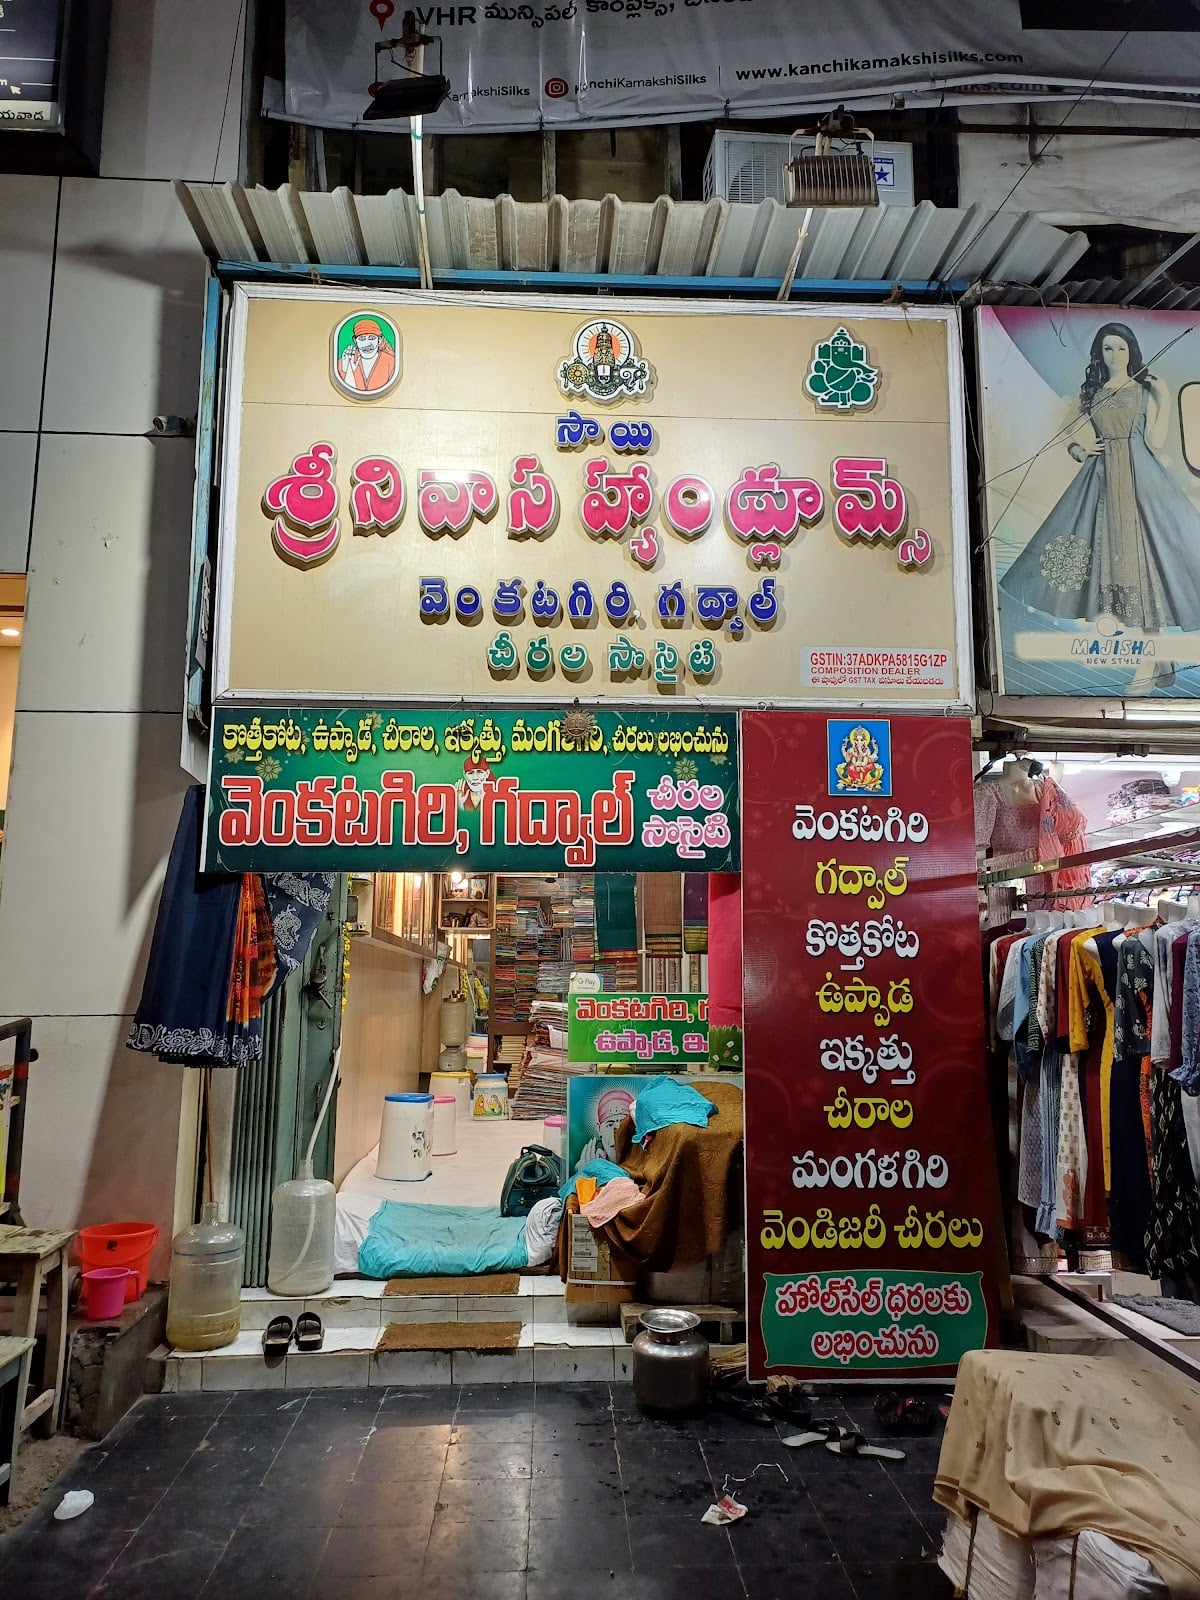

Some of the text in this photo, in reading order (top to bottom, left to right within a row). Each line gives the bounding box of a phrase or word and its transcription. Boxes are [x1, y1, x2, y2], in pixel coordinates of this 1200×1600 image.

[735, 50, 1024, 81] www.kanchikamakshisilks.com
[555, 409, 655, 452] సాయి
[658, 577, 779, 634] గద్వాల్
[488, 630, 589, 673] చీరల
[810, 652, 948, 668] GSTIN:37ADKPA5815G1ZP
[1071, 638, 1156, 656] MAJISHA
[1086, 657, 1142, 665] NEW STYLE
[810, 666, 921, 676] COMPOSITION DEALER
[848, 676, 862, 684] GST
[864, 676, 876, 684] TAX
[611, 724, 654, 753] చీరలు
[646, 775, 725, 811] చీరల
[480, 770, 636, 868] గద్వాల్
[791, 804, 930, 843] వెంకటగిరి
[815, 856, 910, 910] గద్వాల్
[805, 914, 920, 971] కొత్తకోట
[815, 971, 914, 1027] ఉప్పాడ
[819, 1033, 917, 1085] ఇక్కత్తు
[823, 1086, 914, 1129] చీరాల
[791, 1148, 949, 1190] మంగళగిరి
[893, 1205, 984, 1249] చీరలు
[885, 1281, 971, 1321] ధరలకు
[811, 1324, 939, 1364] లభించును
